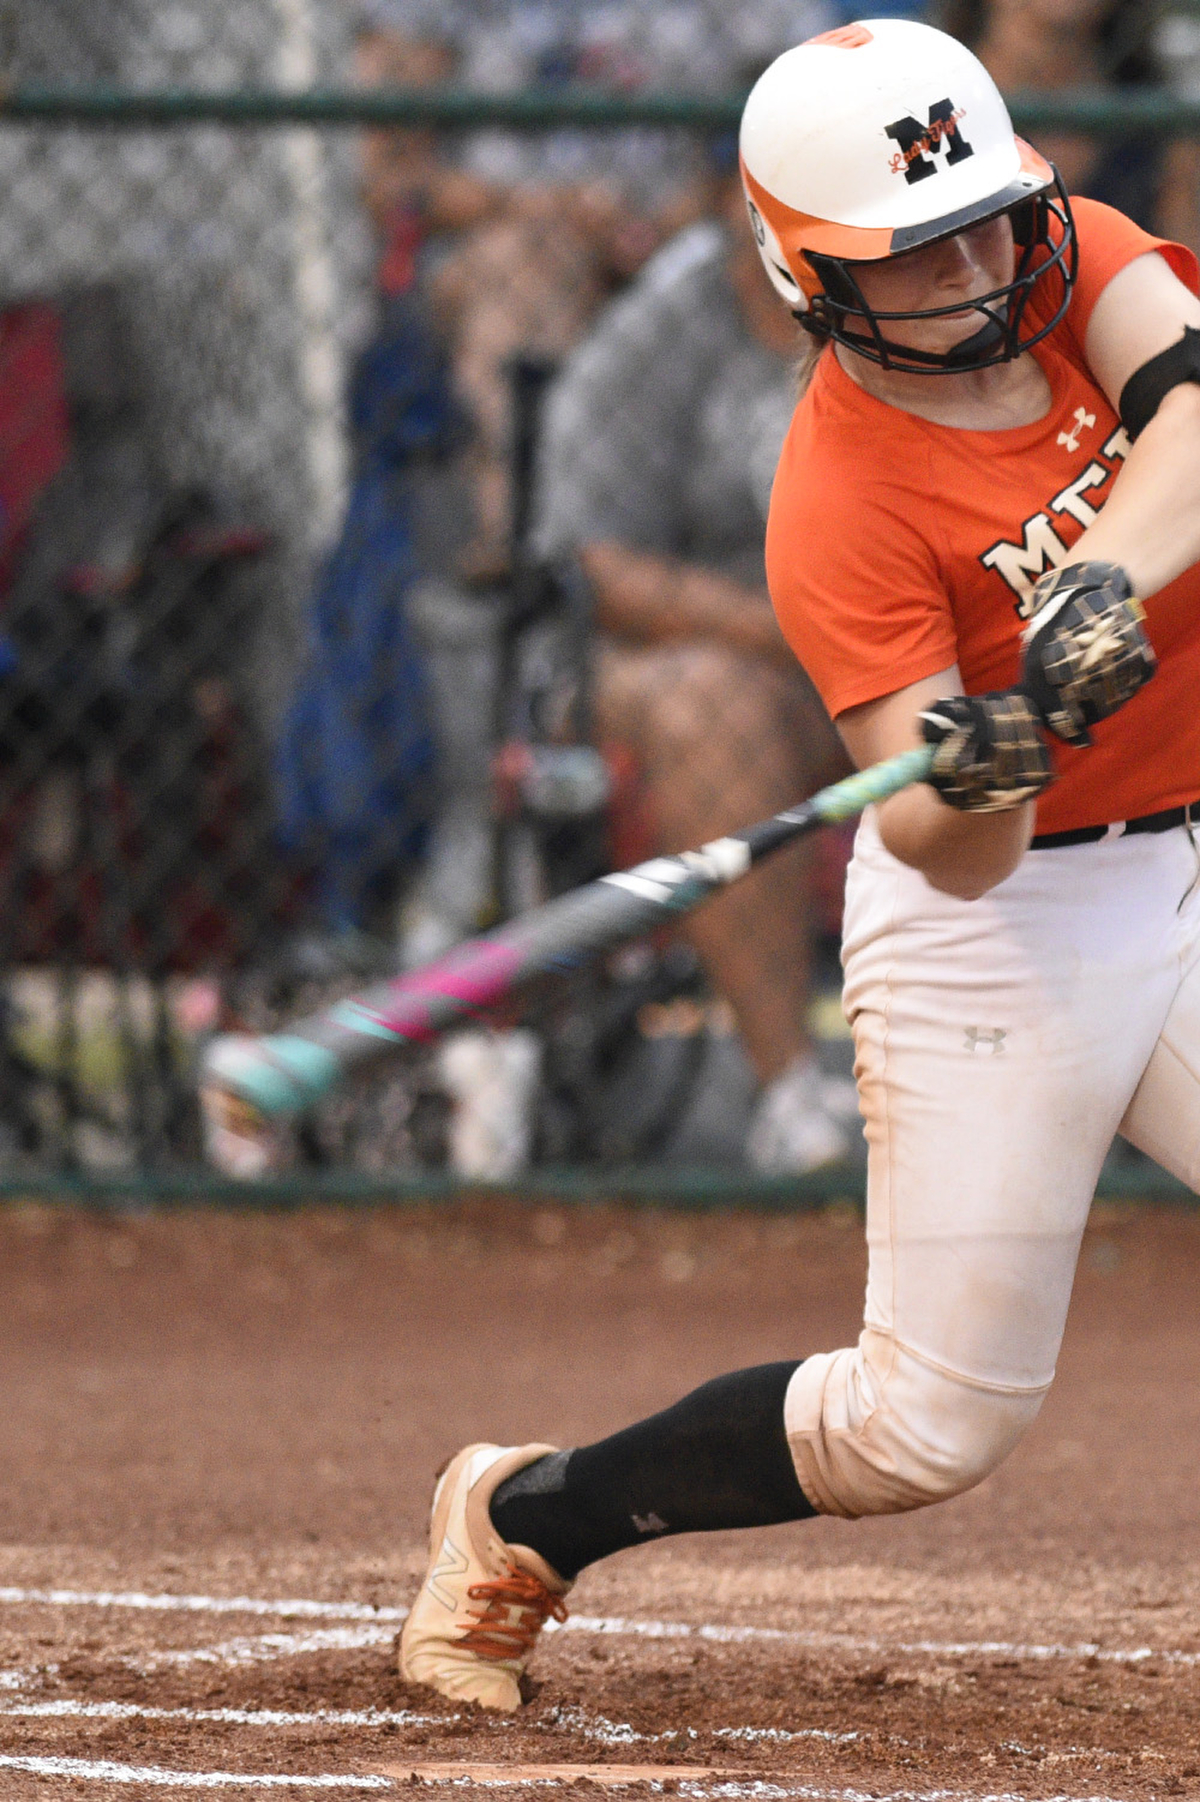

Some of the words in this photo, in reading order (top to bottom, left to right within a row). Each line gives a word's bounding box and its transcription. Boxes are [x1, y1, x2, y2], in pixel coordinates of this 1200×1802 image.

[884, 97, 974, 185] M
[888, 136, 931, 174] Lady
[927, 107, 967, 143] Tigers
